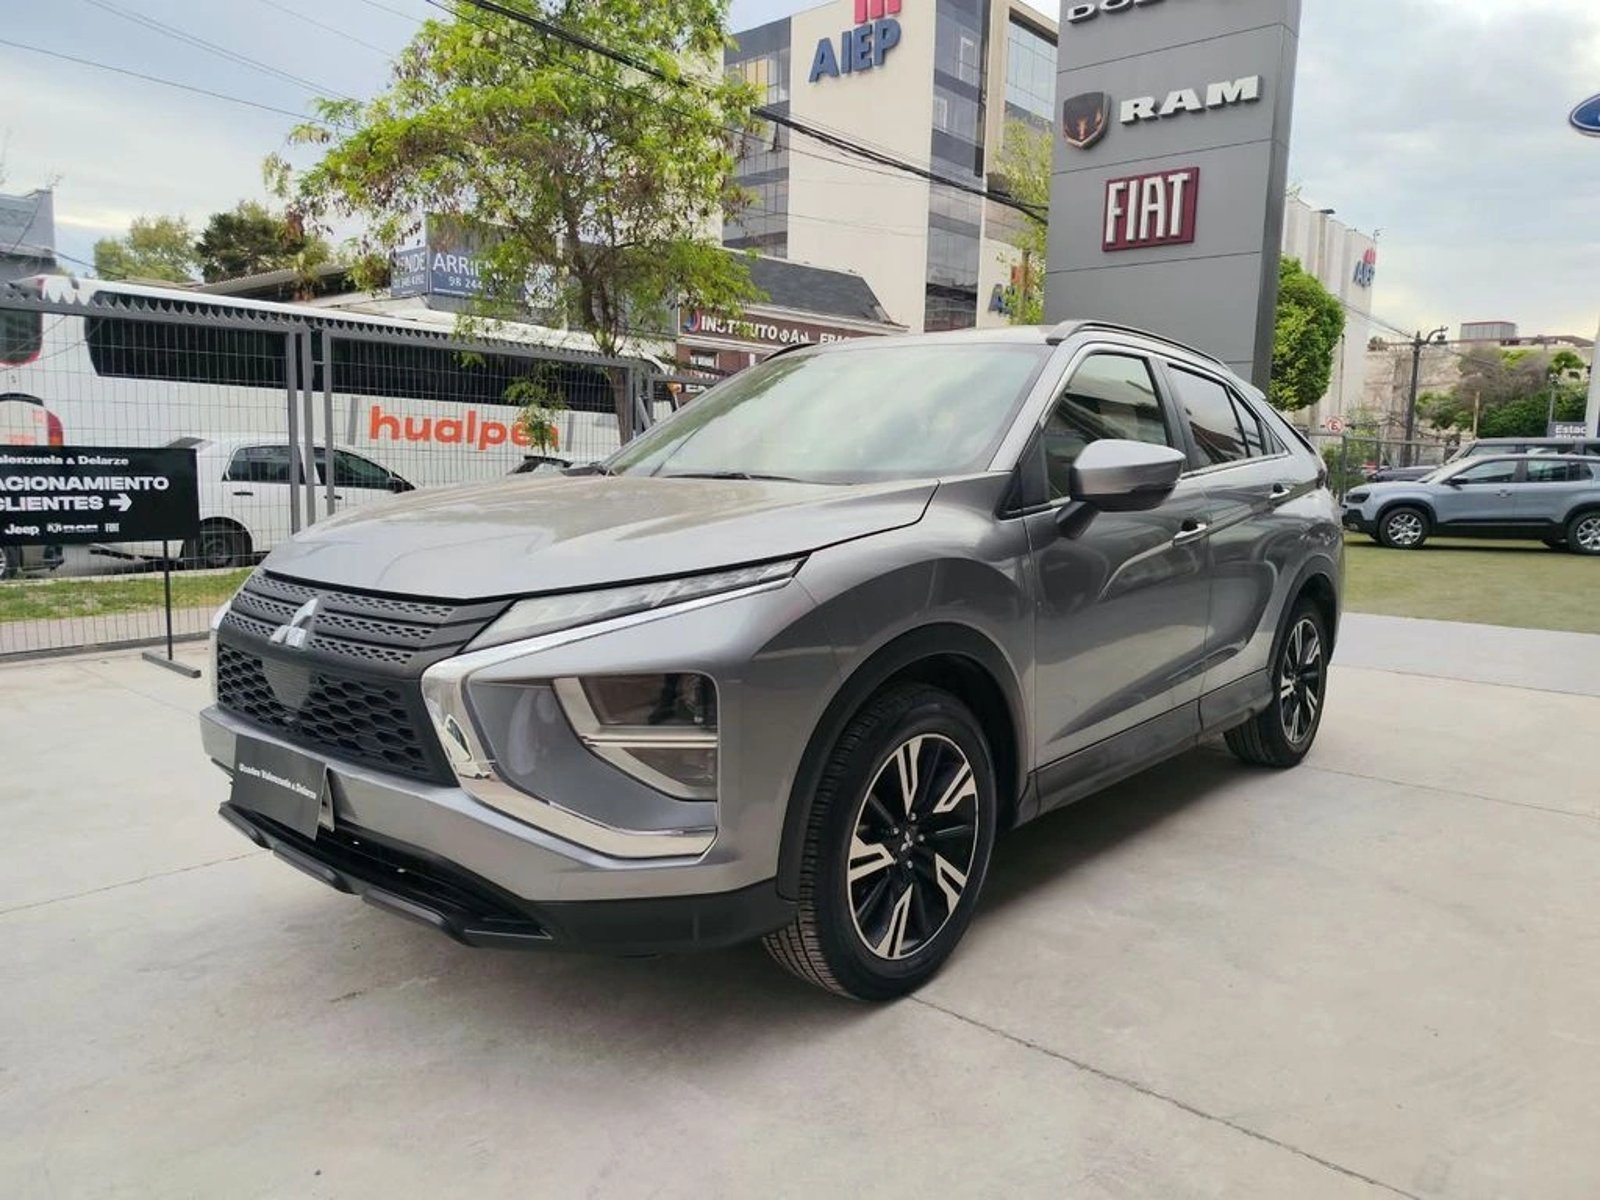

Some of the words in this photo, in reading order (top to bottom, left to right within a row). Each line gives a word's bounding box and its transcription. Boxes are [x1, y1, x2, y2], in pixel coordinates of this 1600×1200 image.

[809, 18, 901, 84] AIEP
[1120, 75, 1261, 124] RAM
[1105, 172, 1191, 244] FIAT
[78, 455, 129, 466] Delarze
[4, 523, 40, 536] Jeep
